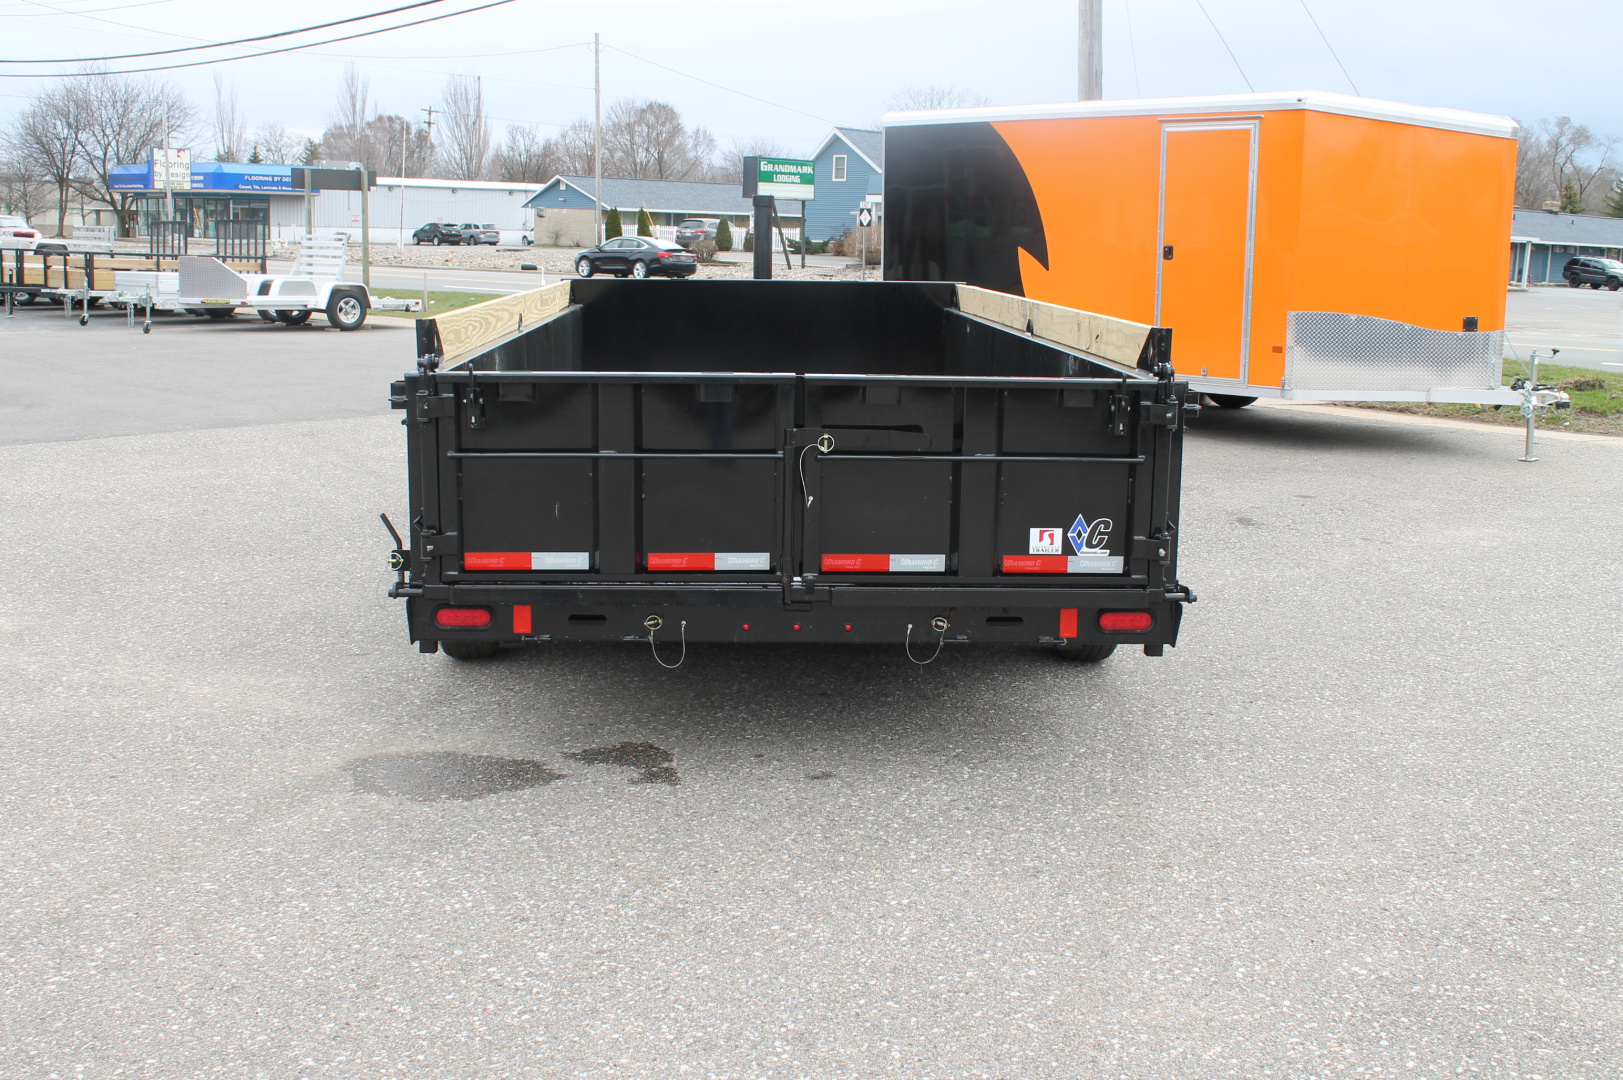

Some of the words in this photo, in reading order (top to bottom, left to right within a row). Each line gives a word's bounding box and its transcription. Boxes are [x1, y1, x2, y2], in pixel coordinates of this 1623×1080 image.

[760, 161, 814, 174] GRANDMARK
[154, 171, 162, 179] by
[773, 174, 800, 183] LODGING
